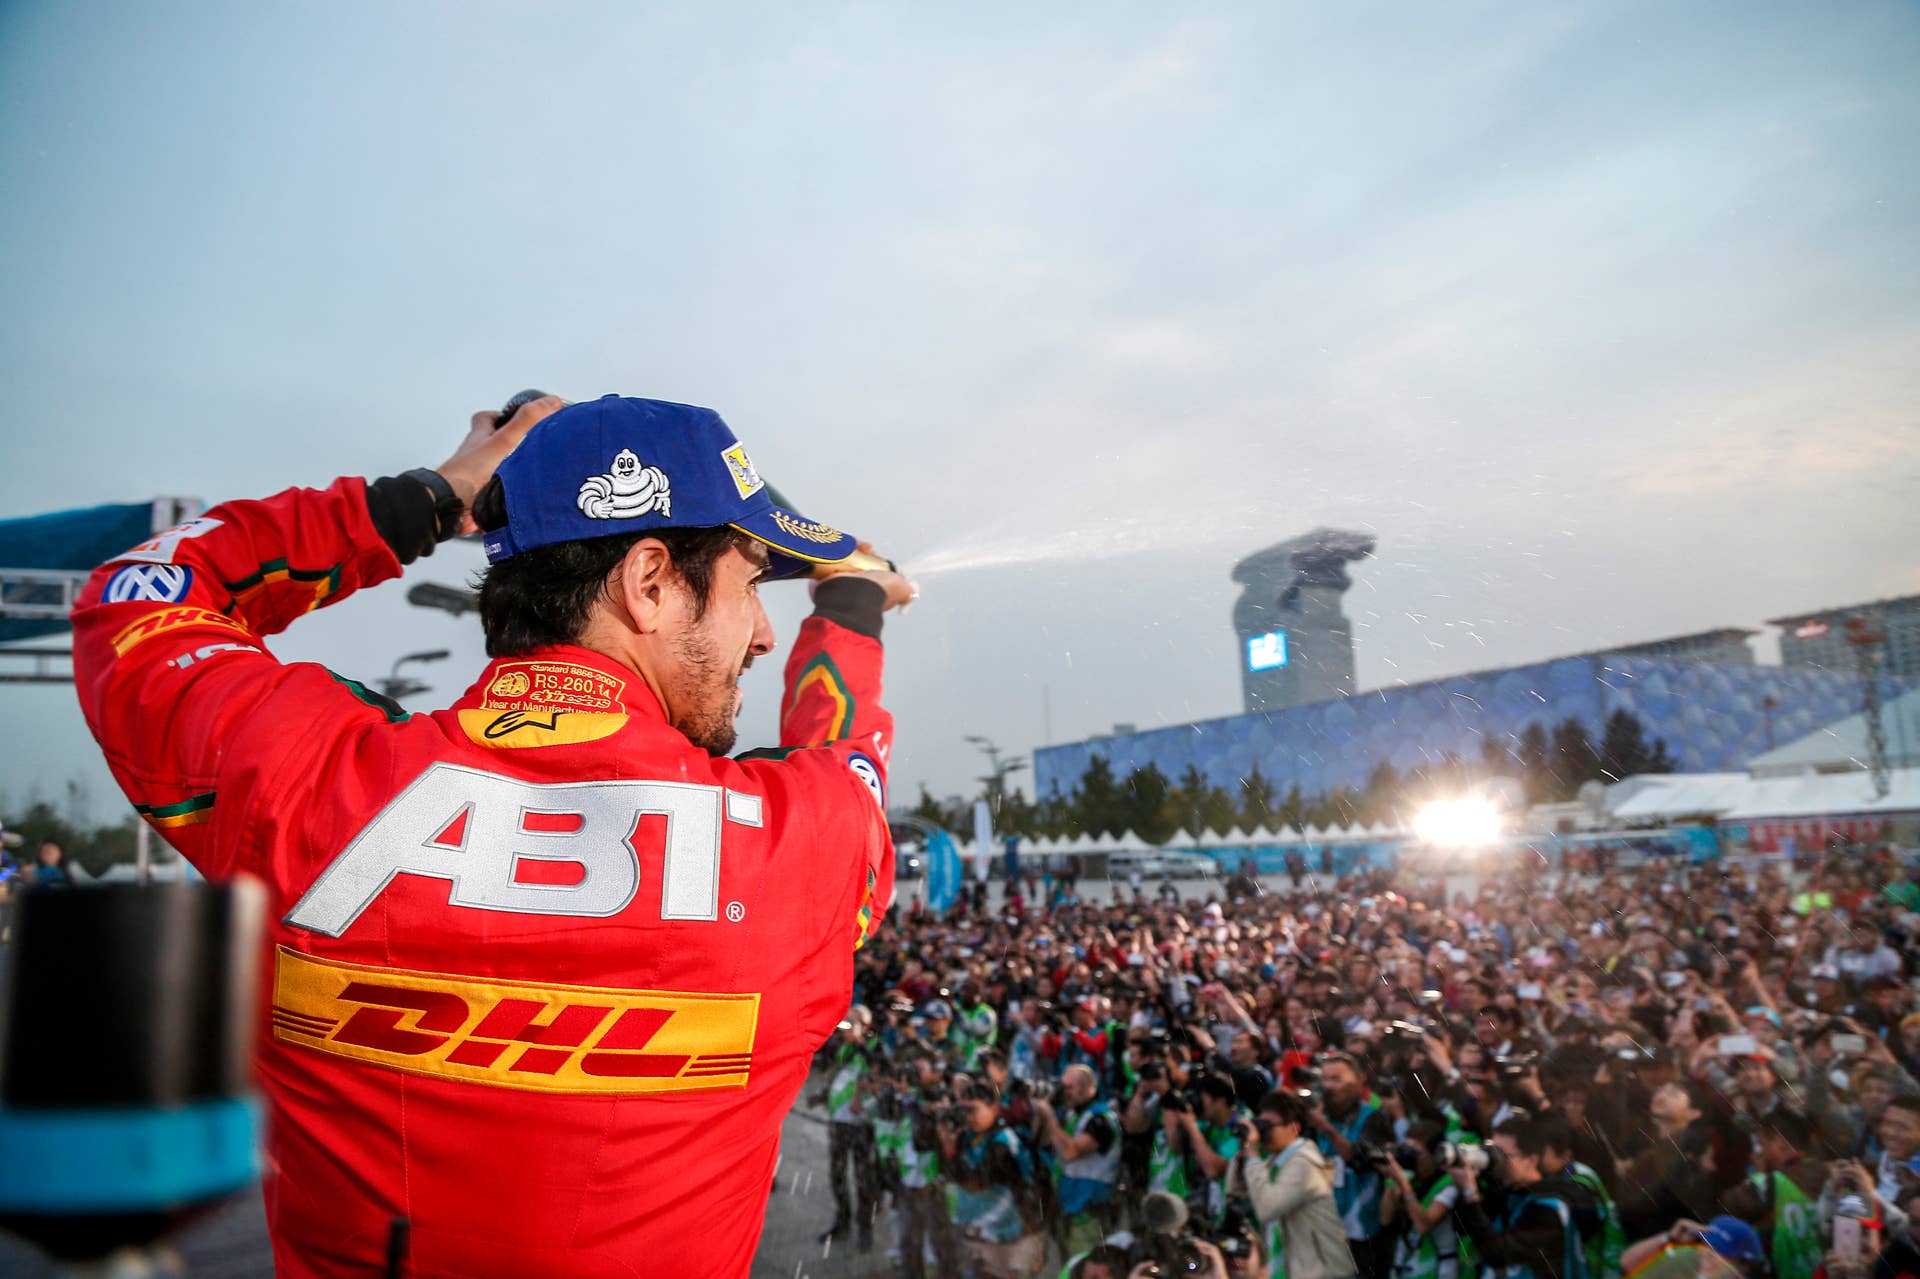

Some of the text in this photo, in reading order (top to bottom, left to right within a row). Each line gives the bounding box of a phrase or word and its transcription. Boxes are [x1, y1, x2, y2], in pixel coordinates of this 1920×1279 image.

[530, 664, 569, 674] Standard
[534, 673, 612, 699] RS.260.14
[488, 699, 507, 710] Year
[510, 700, 521, 711] of
[281, 760, 723, 938] ABT
[330, 982, 692, 1078] DHL
